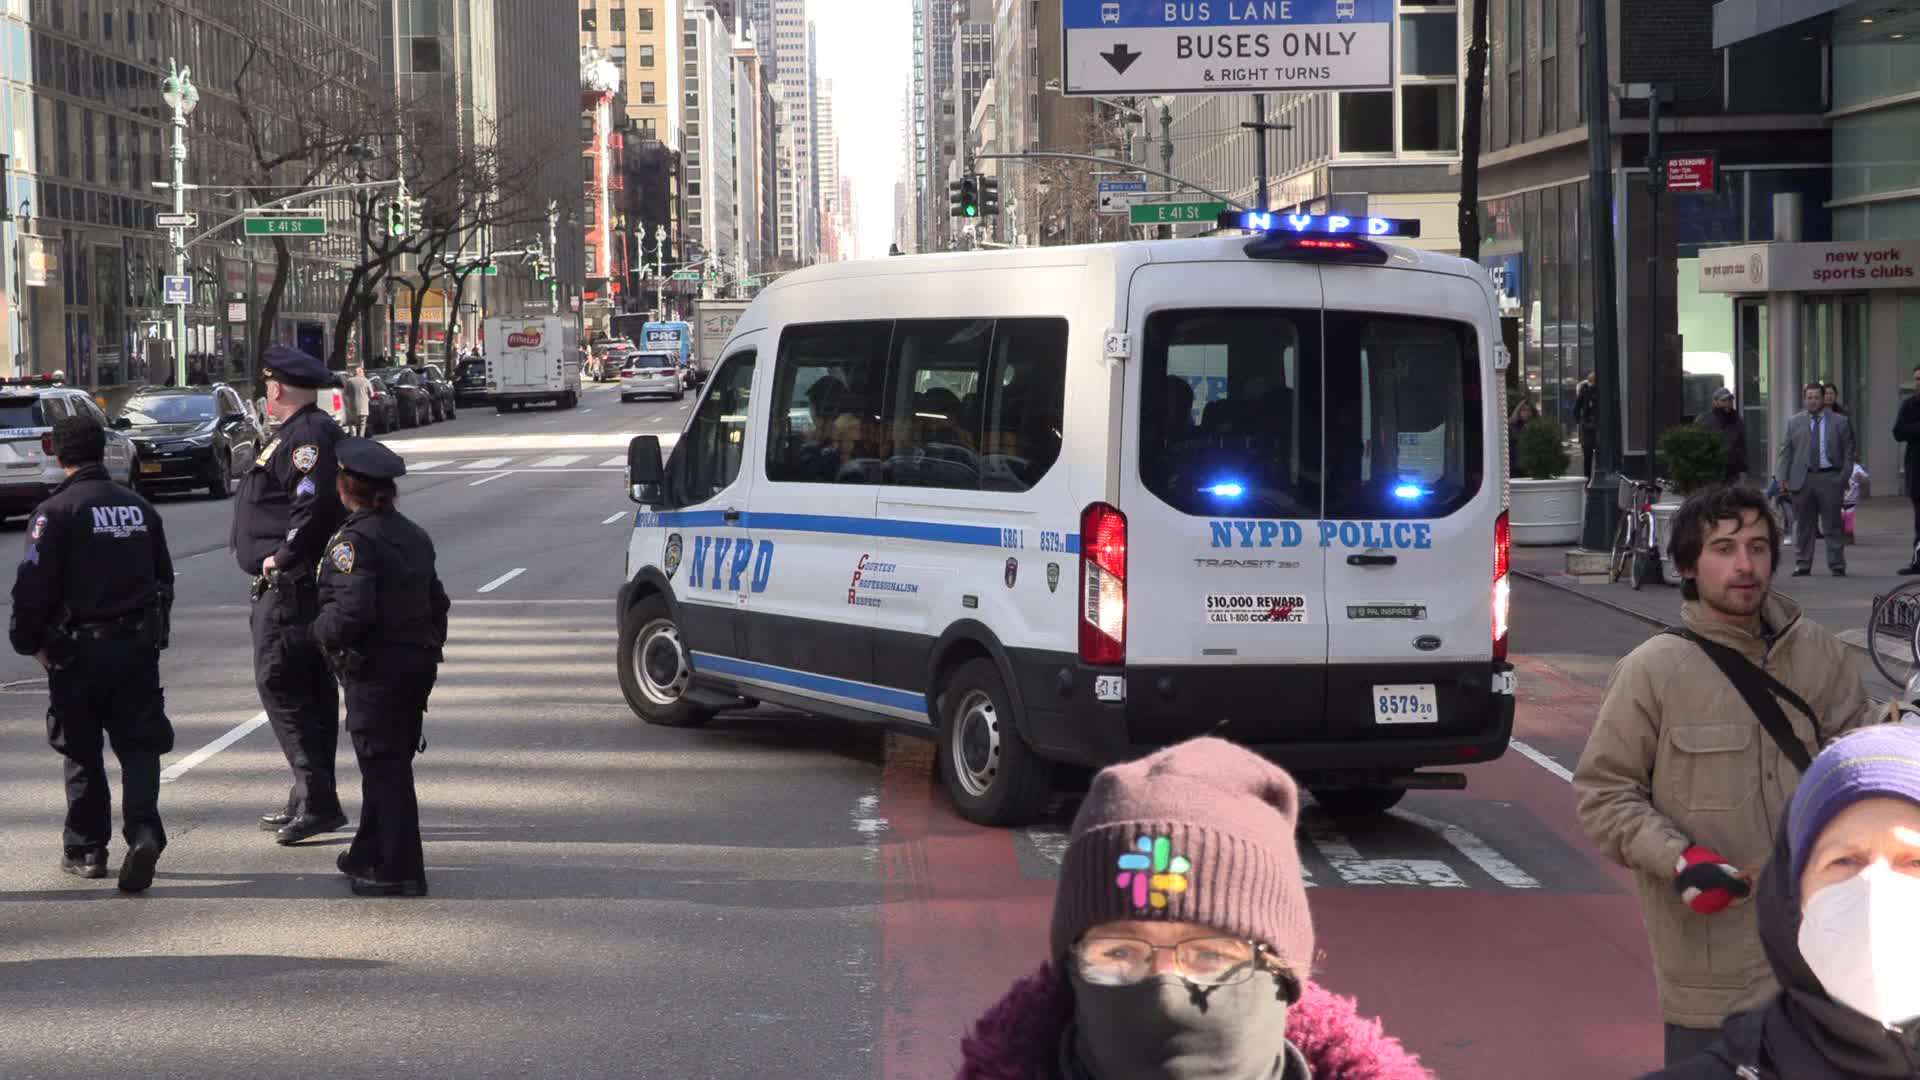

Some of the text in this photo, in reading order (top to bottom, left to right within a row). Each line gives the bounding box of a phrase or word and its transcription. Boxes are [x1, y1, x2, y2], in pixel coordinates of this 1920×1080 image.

[1165, 1, 1293, 22] BUS LANE
[1177, 32, 1357, 59] BUSES ONLY
[1203, 66, 1331, 82] & RIGHT TURNS
[1158, 206, 1200, 220] E 41 St
[268, 221, 302, 232] E 41 St
[1825, 248, 1900, 265] new york
[1813, 264, 1914, 283] sports clubs
[650, 331, 678, 341] PAC
[91, 505, 144, 527] NYPD
[1003, 528, 1018, 549] SRG
[1210, 520, 1432, 549] NYPD POLICE
[689, 535, 775, 593] NYPD
[1193, 558, 1276, 568] TRANSIT
[1207, 595, 1304, 609] $10,000 REWARD
[1210, 614, 1229, 623] CALL
[1230, 613, 1249, 623] 1-800
[1366, 607, 1412, 616] PAL INSPIRES
